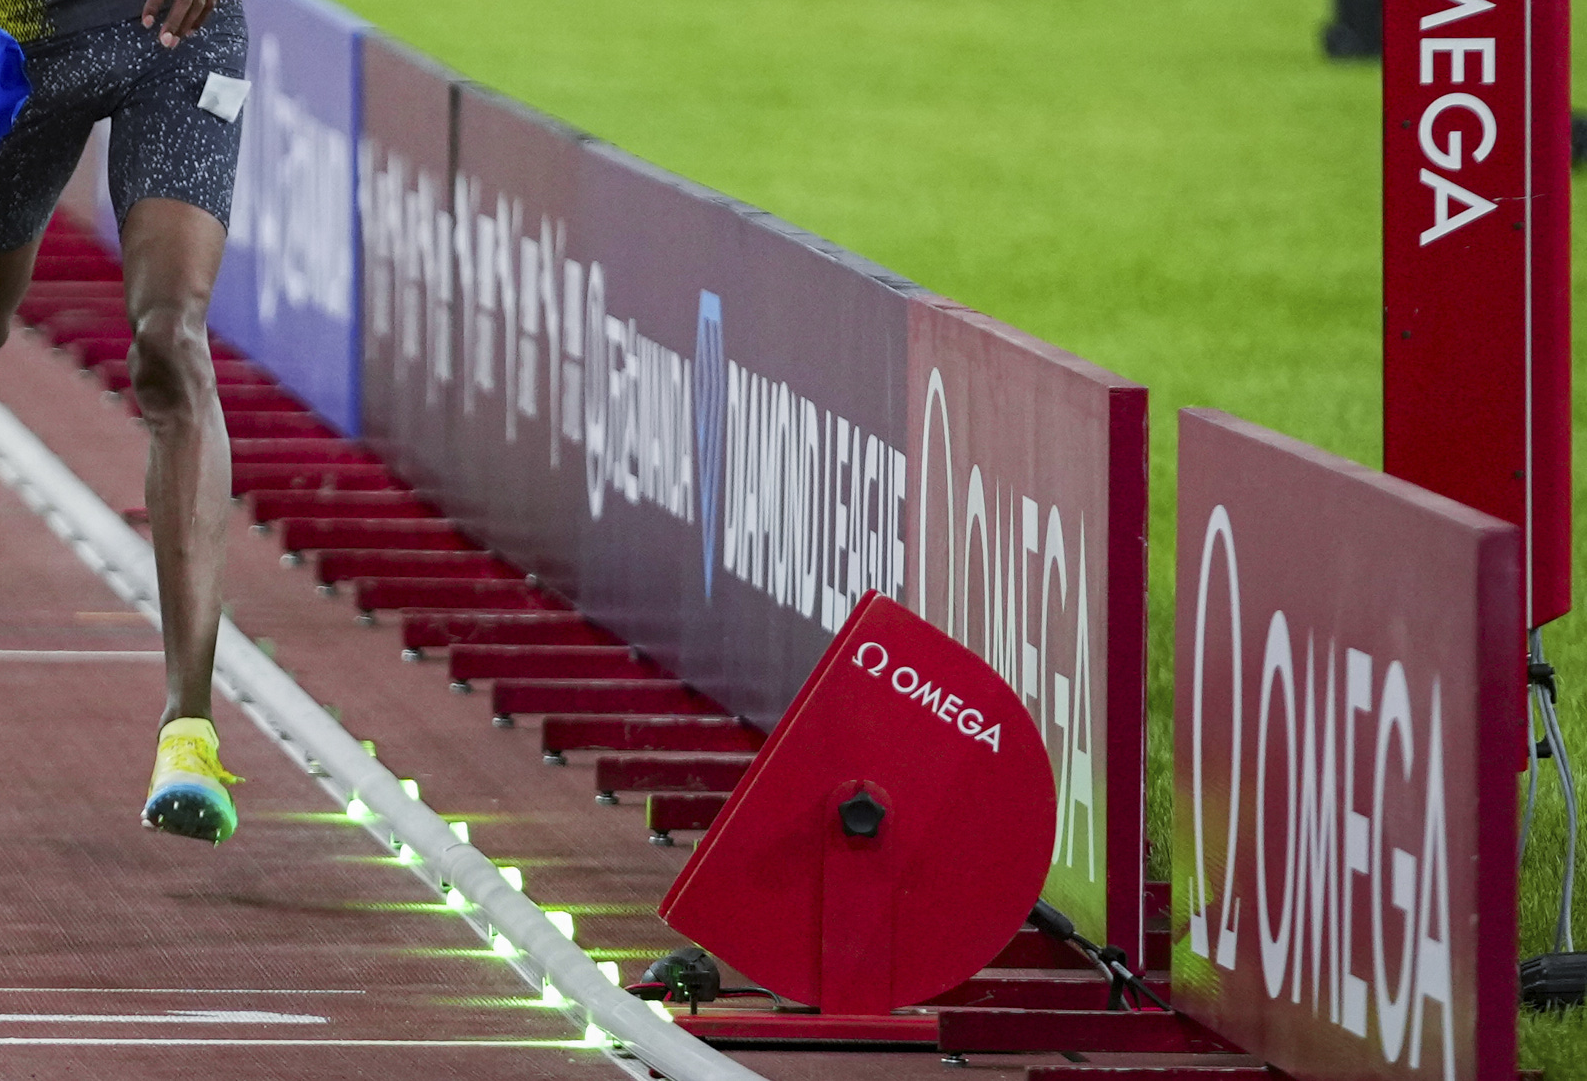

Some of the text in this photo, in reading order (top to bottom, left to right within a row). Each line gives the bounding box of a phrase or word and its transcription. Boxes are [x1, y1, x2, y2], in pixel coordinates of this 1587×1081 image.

[723, 359, 819, 619] DIAMOND
[821, 409, 907, 635] LEAGUE
[891, 666, 1002, 753] OMEGA
[1256, 609, 1457, 1081] OMEGA
